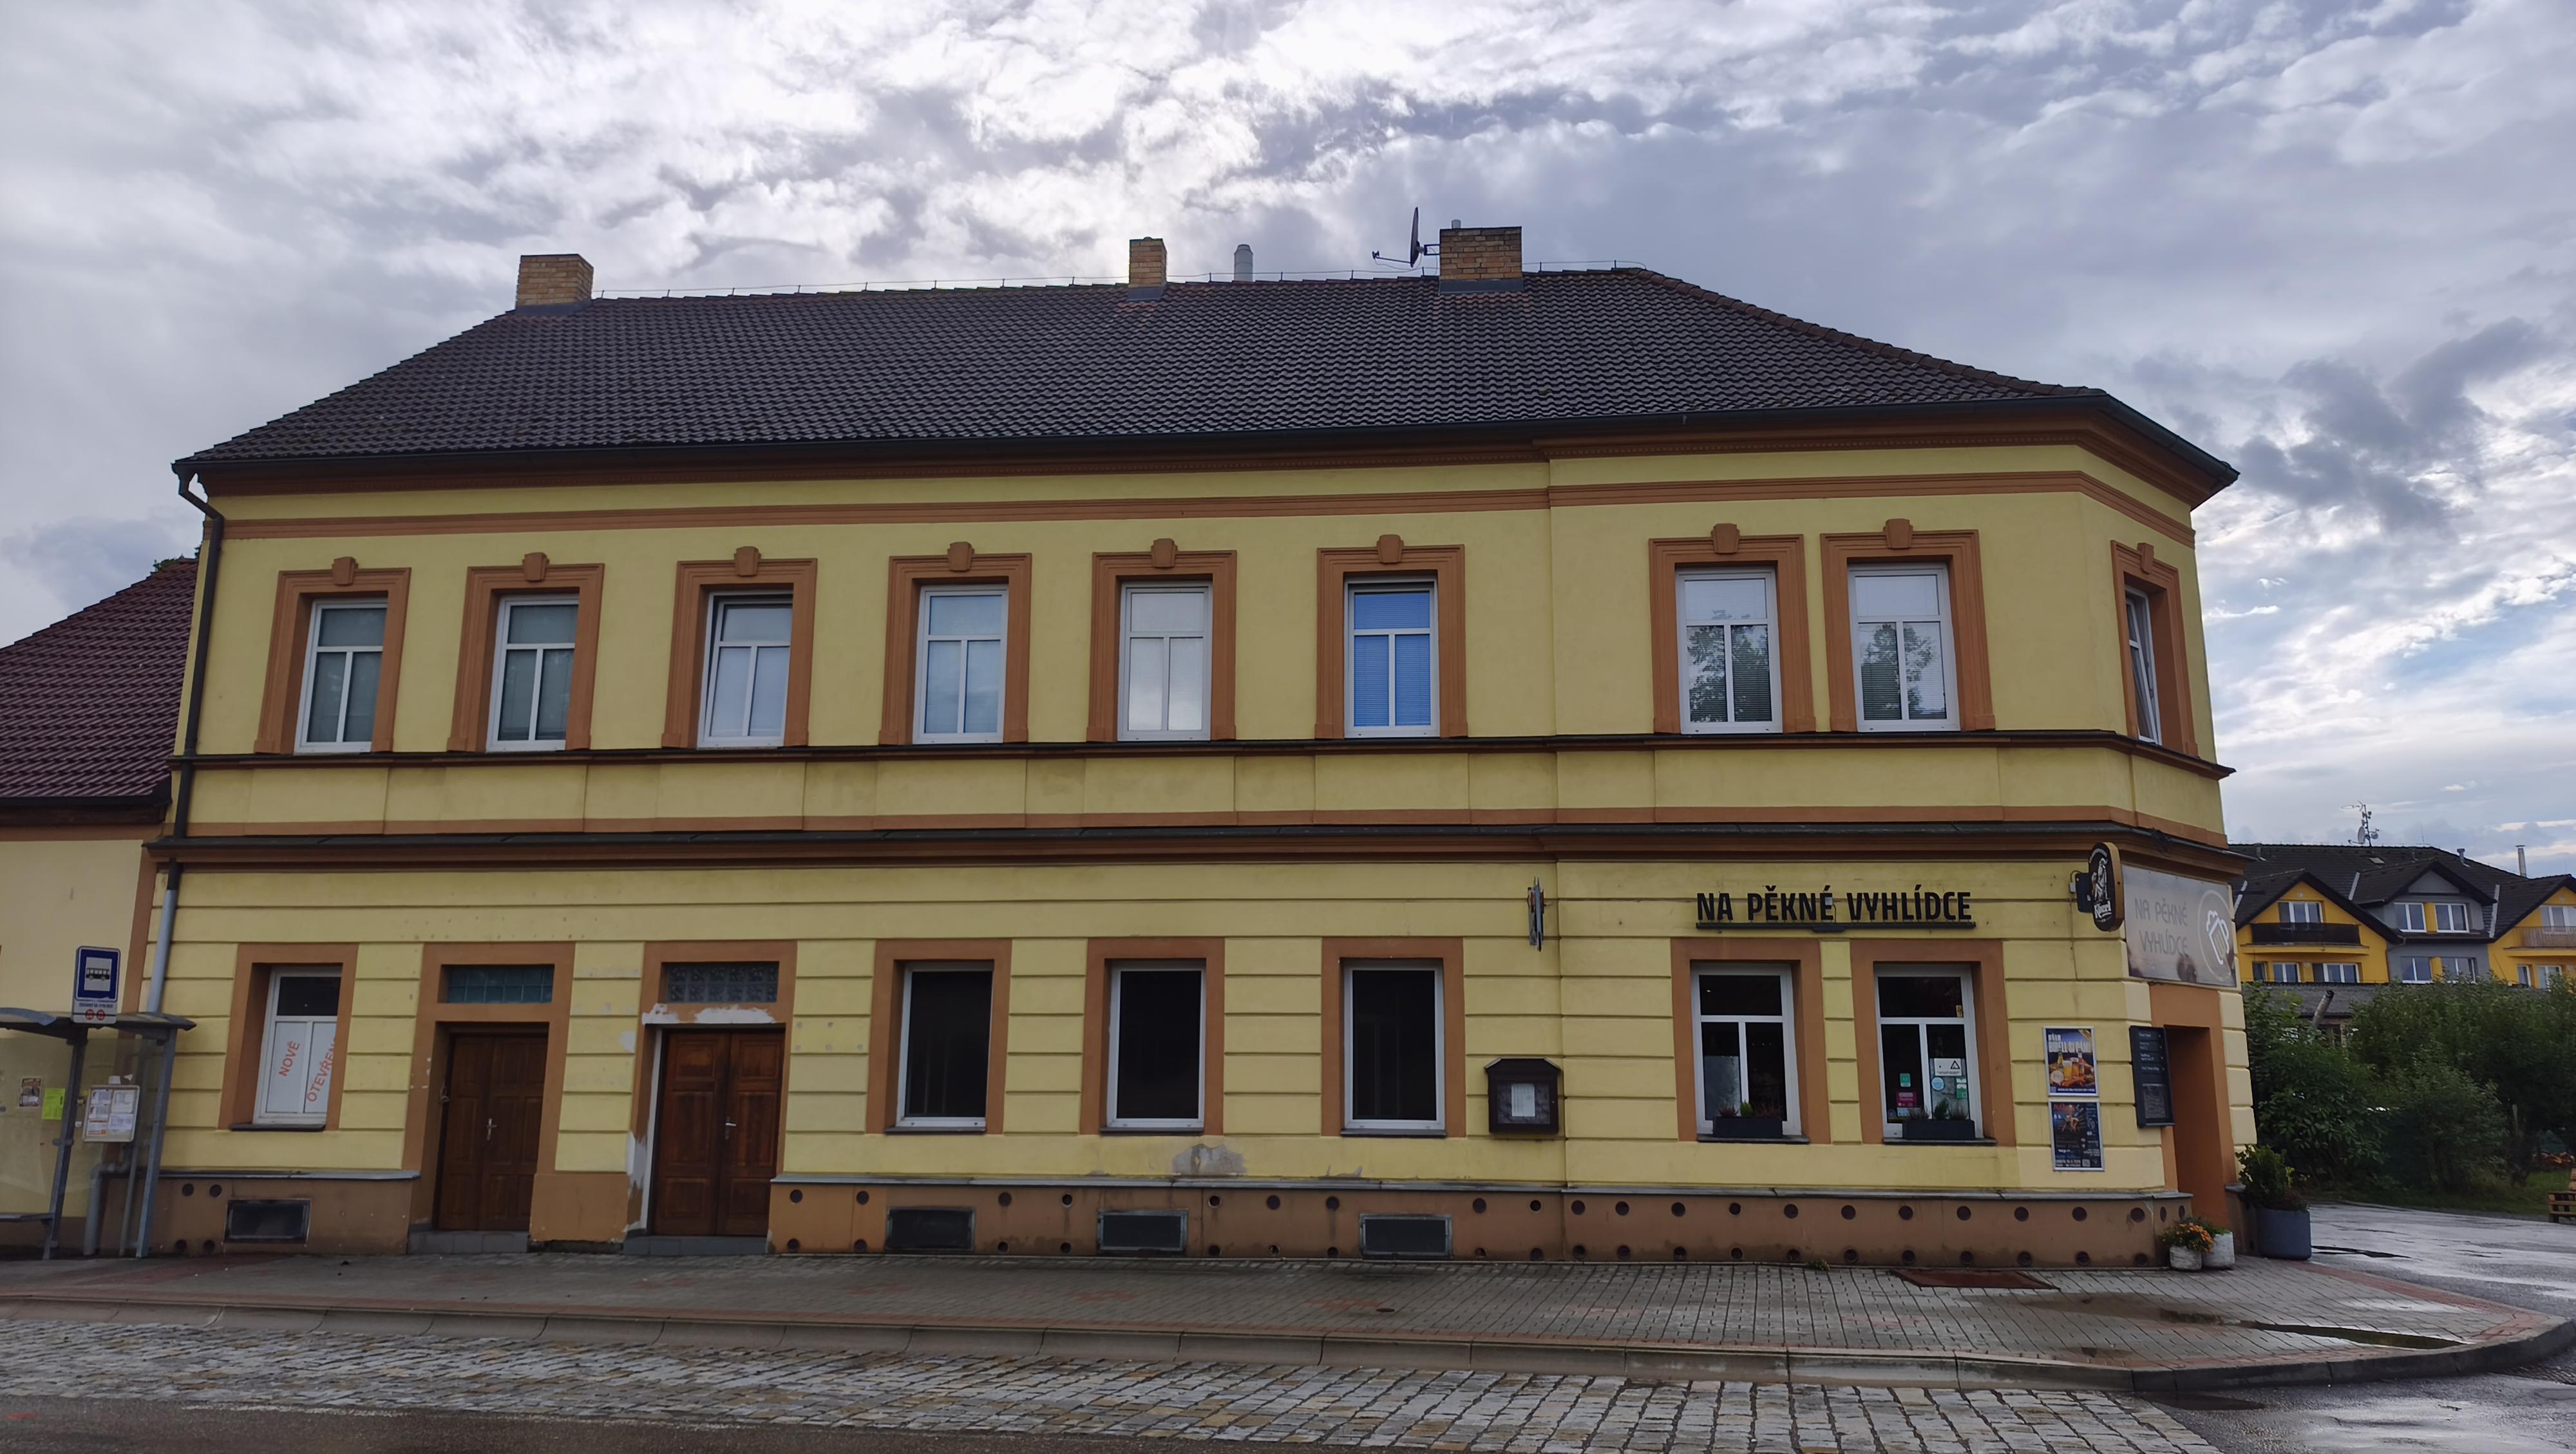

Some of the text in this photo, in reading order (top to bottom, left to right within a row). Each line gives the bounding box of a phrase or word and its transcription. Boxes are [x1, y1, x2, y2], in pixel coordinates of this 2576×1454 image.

[1696, 884, 1972, 921] NA PĚKNÉ VYHLÍDCE
[2134, 897, 2188, 926] NA PĚKNÉ
[2138, 929, 2189, 958] VYHLÍDCE
[279, 1041, 300, 1076] NOVÉ
